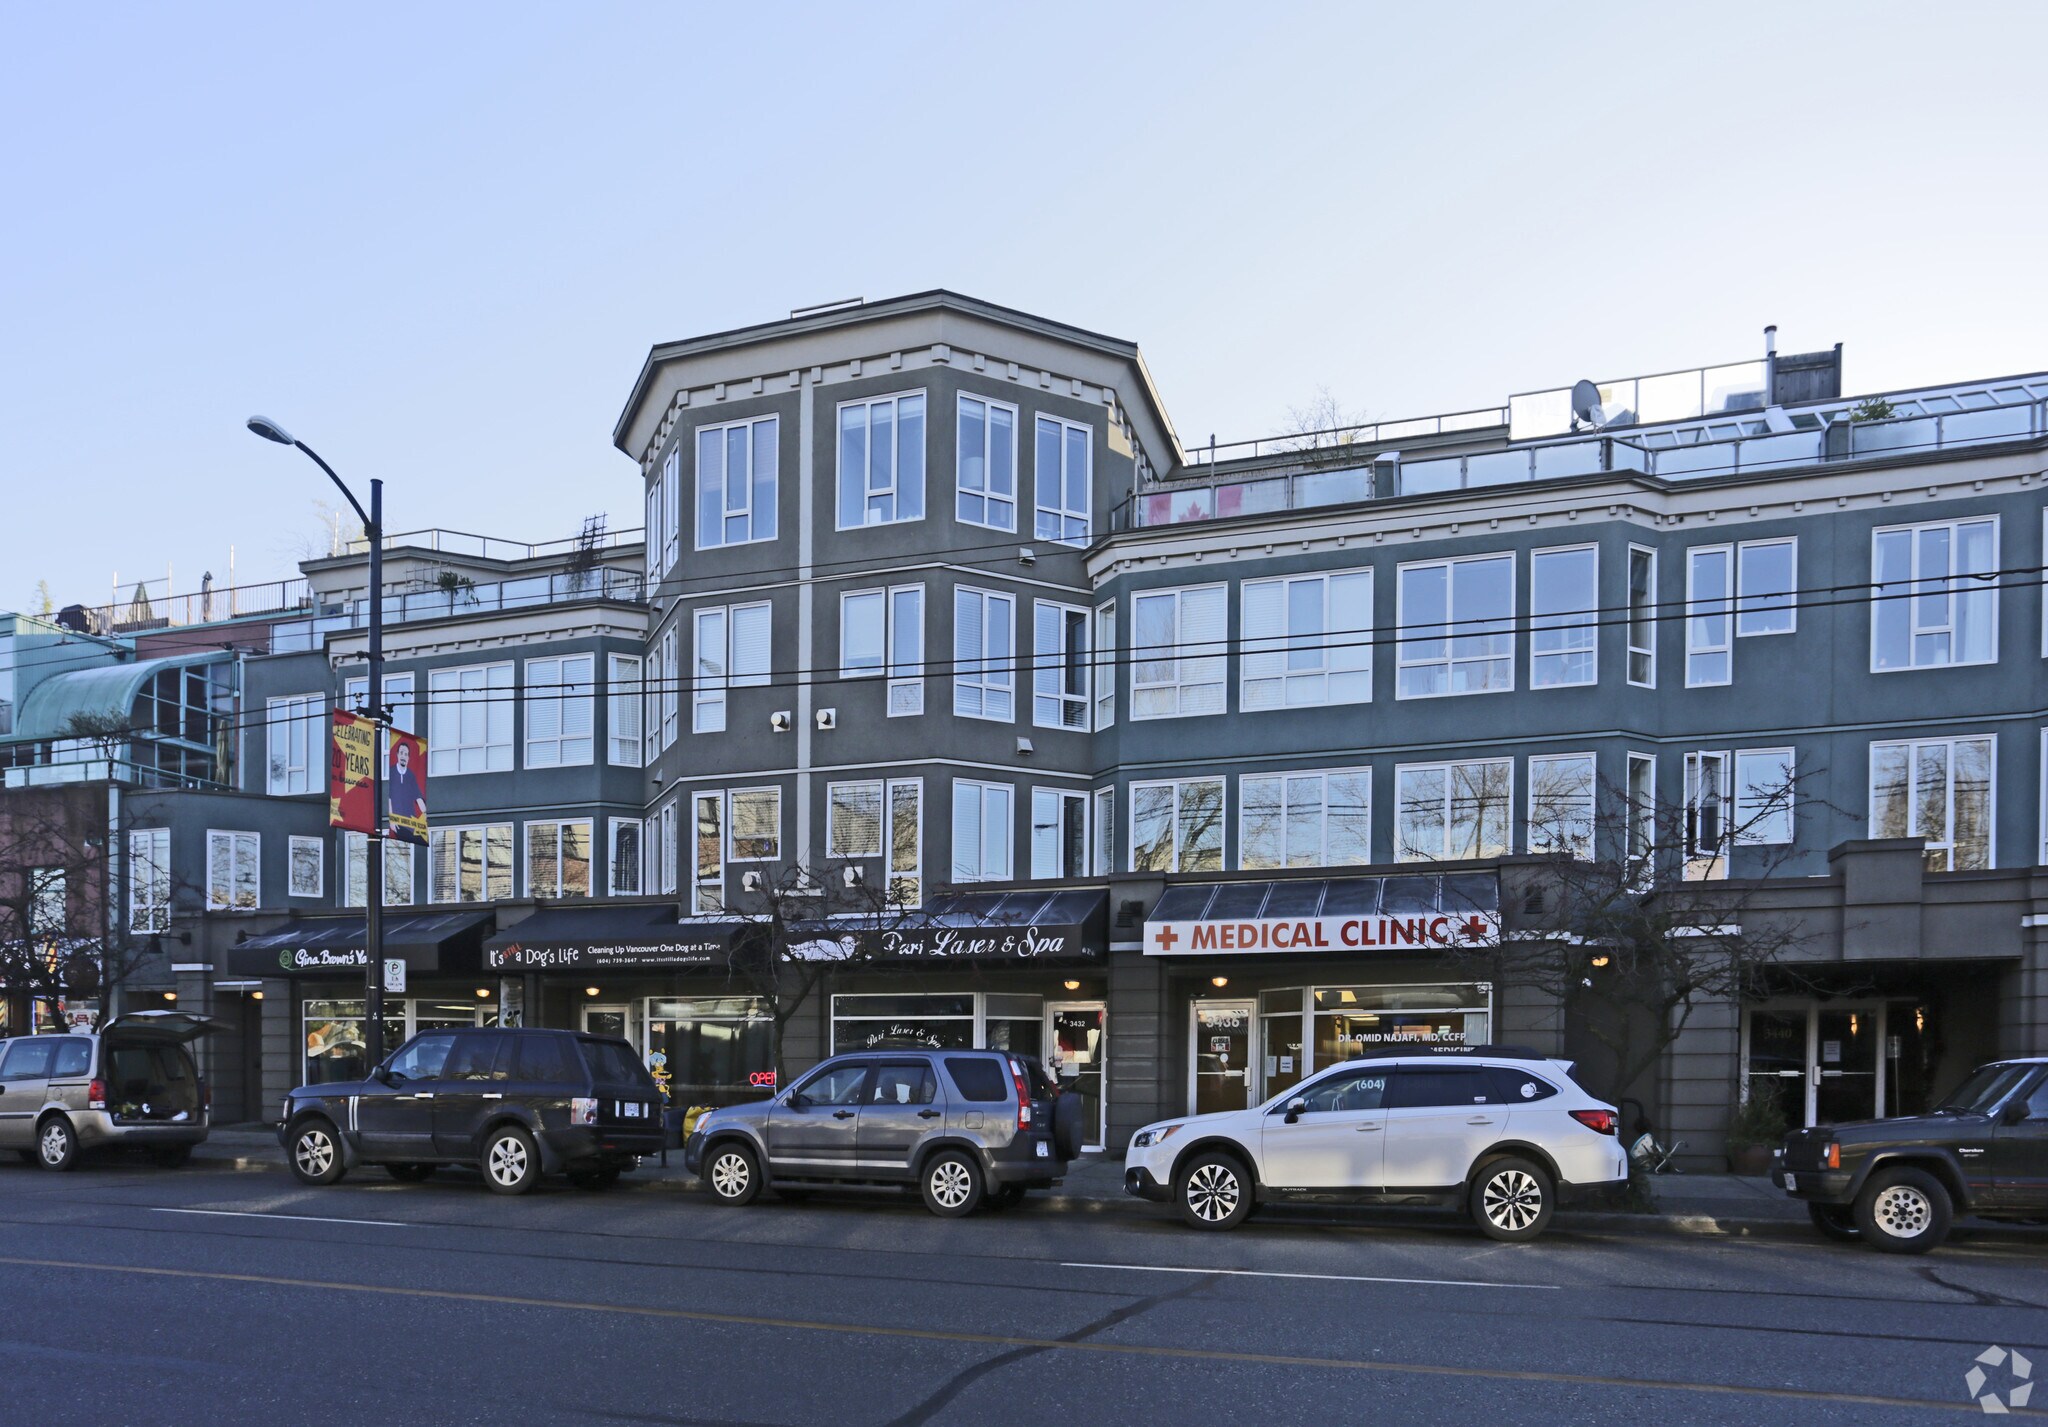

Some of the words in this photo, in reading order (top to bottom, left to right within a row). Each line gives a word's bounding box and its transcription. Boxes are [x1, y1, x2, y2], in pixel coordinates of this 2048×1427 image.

[333, 721, 371, 746] CELEBRATING
[345, 752, 370, 776] YEARS
[929, 926, 997, 956] Laser
[1001, 935, 1015, 952] &
[1017, 926, 1064, 957] Spa
[1191, 921, 1329, 949] MEDICAL
[1340, 917, 1449, 947] CLINIC
[295, 948, 319, 967] Gina
[320, 949, 354, 965] Brown's
[355, 949, 368, 965] Ya
[490, 949, 504, 967] It's
[502, 942, 523, 959] STILL
[515, 951, 521, 962] a
[525, 948, 555, 967] Dog's
[558, 947, 579, 965] Life
[587, 946, 614, 955] Cleaning
[615, 945, 625, 955] Up
[626, 945, 659, 953] Vancouver
[660, 943, 674, 952] One
[675, 943, 689, 953] Dog
[1069, 1020, 1086, 1028] 3432
[1206, 1015, 1240, 1028] 3436
[866, 1030, 885, 1049] Pari
[890, 1024, 914, 1036] Laser
[916, 1028, 926, 1037] &
[926, 1034, 942, 1049] Spa
[1338, 1033, 1355, 1043] DR.
[1355, 1033, 1382, 1042] OMID
[1383, 1033, 1421, 1043] NAJAFI,
[1422, 1033, 1441, 1042] MD,
[1442, 1032, 1467, 1042] CCFP
[1356, 1079, 1386, 1092] (604)
